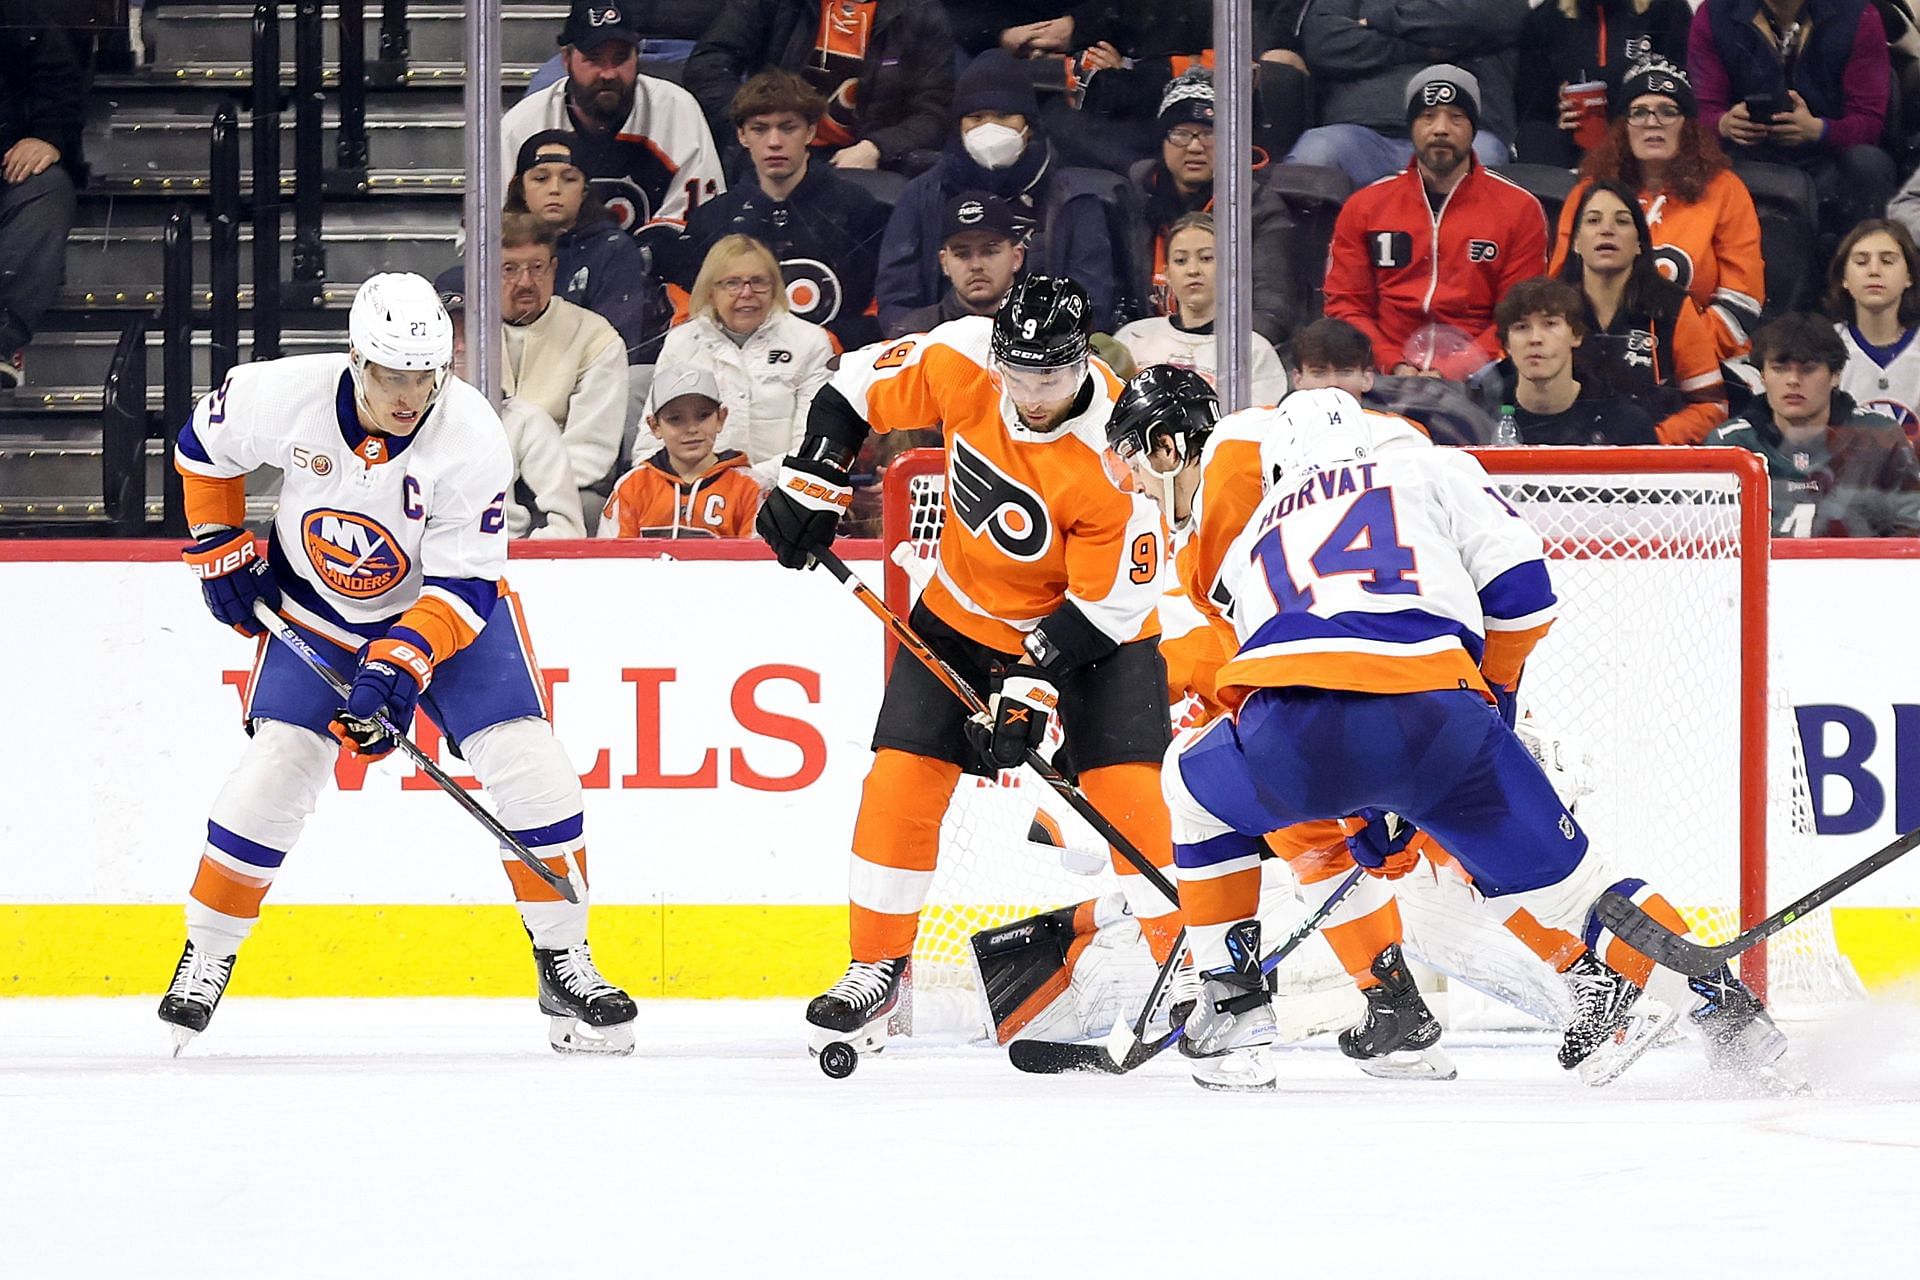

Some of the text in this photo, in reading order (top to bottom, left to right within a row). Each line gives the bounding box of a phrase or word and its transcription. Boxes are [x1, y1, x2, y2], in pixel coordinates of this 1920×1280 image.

[1377, 233, 1395, 266] 1
[410, 322, 426, 336] 27
[1022, 318, 1038, 340] 9
[1010, 349, 1044, 361] CCM
[1327, 411, 1342, 425] 14
[403, 474, 424, 520] C
[703, 493, 726, 526] C
[1257, 462, 1378, 536] HORVAT
[1129, 531, 1157, 585] 9
[1250, 485, 1424, 614] 14
[310, 544, 391, 590] ISLANDERS
